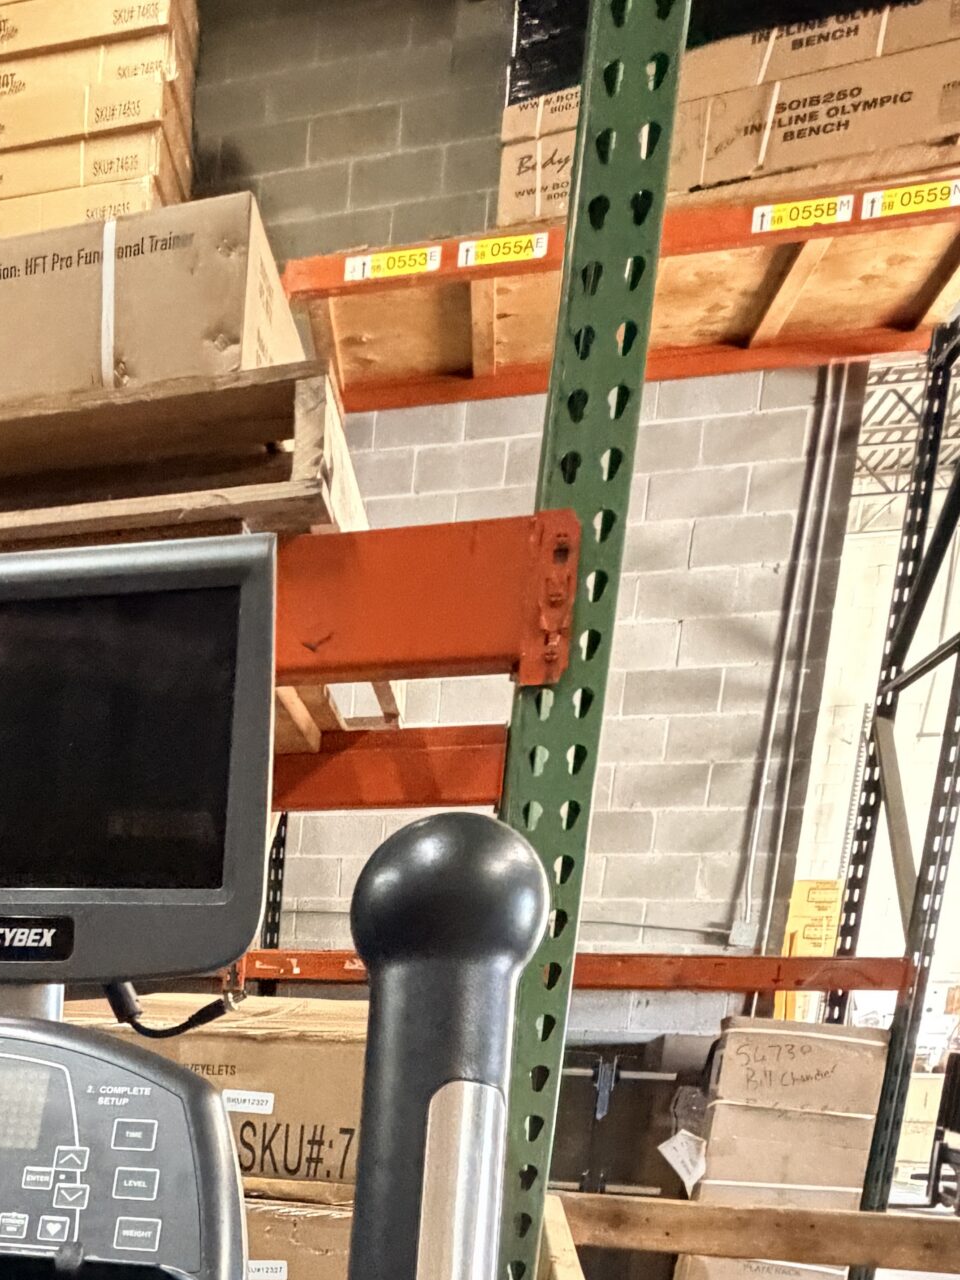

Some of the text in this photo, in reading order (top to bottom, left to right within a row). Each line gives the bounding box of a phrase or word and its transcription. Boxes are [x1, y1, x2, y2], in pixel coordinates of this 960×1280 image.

[791, 24, 859, 51] BENCH
[744, 110, 819, 137] INLINE
[826, 91, 913, 118] OLYMPIC
[782, 120, 850, 143] BENCH
[25, 255, 48, 276] HFT
[52, 253, 73, 271] Pro
[77, 237, 145, 267] Funonal
[99, 1085, 152, 1096] COMPLETE
[97, 1097, 130, 1106] SETUP
[125, 1130, 143, 1139] TIME
[26, 1174, 50, 1183] ENTER
[123, 1180, 148, 1189] LEVEL
[121, 1229, 153, 1239] WEIGHT
